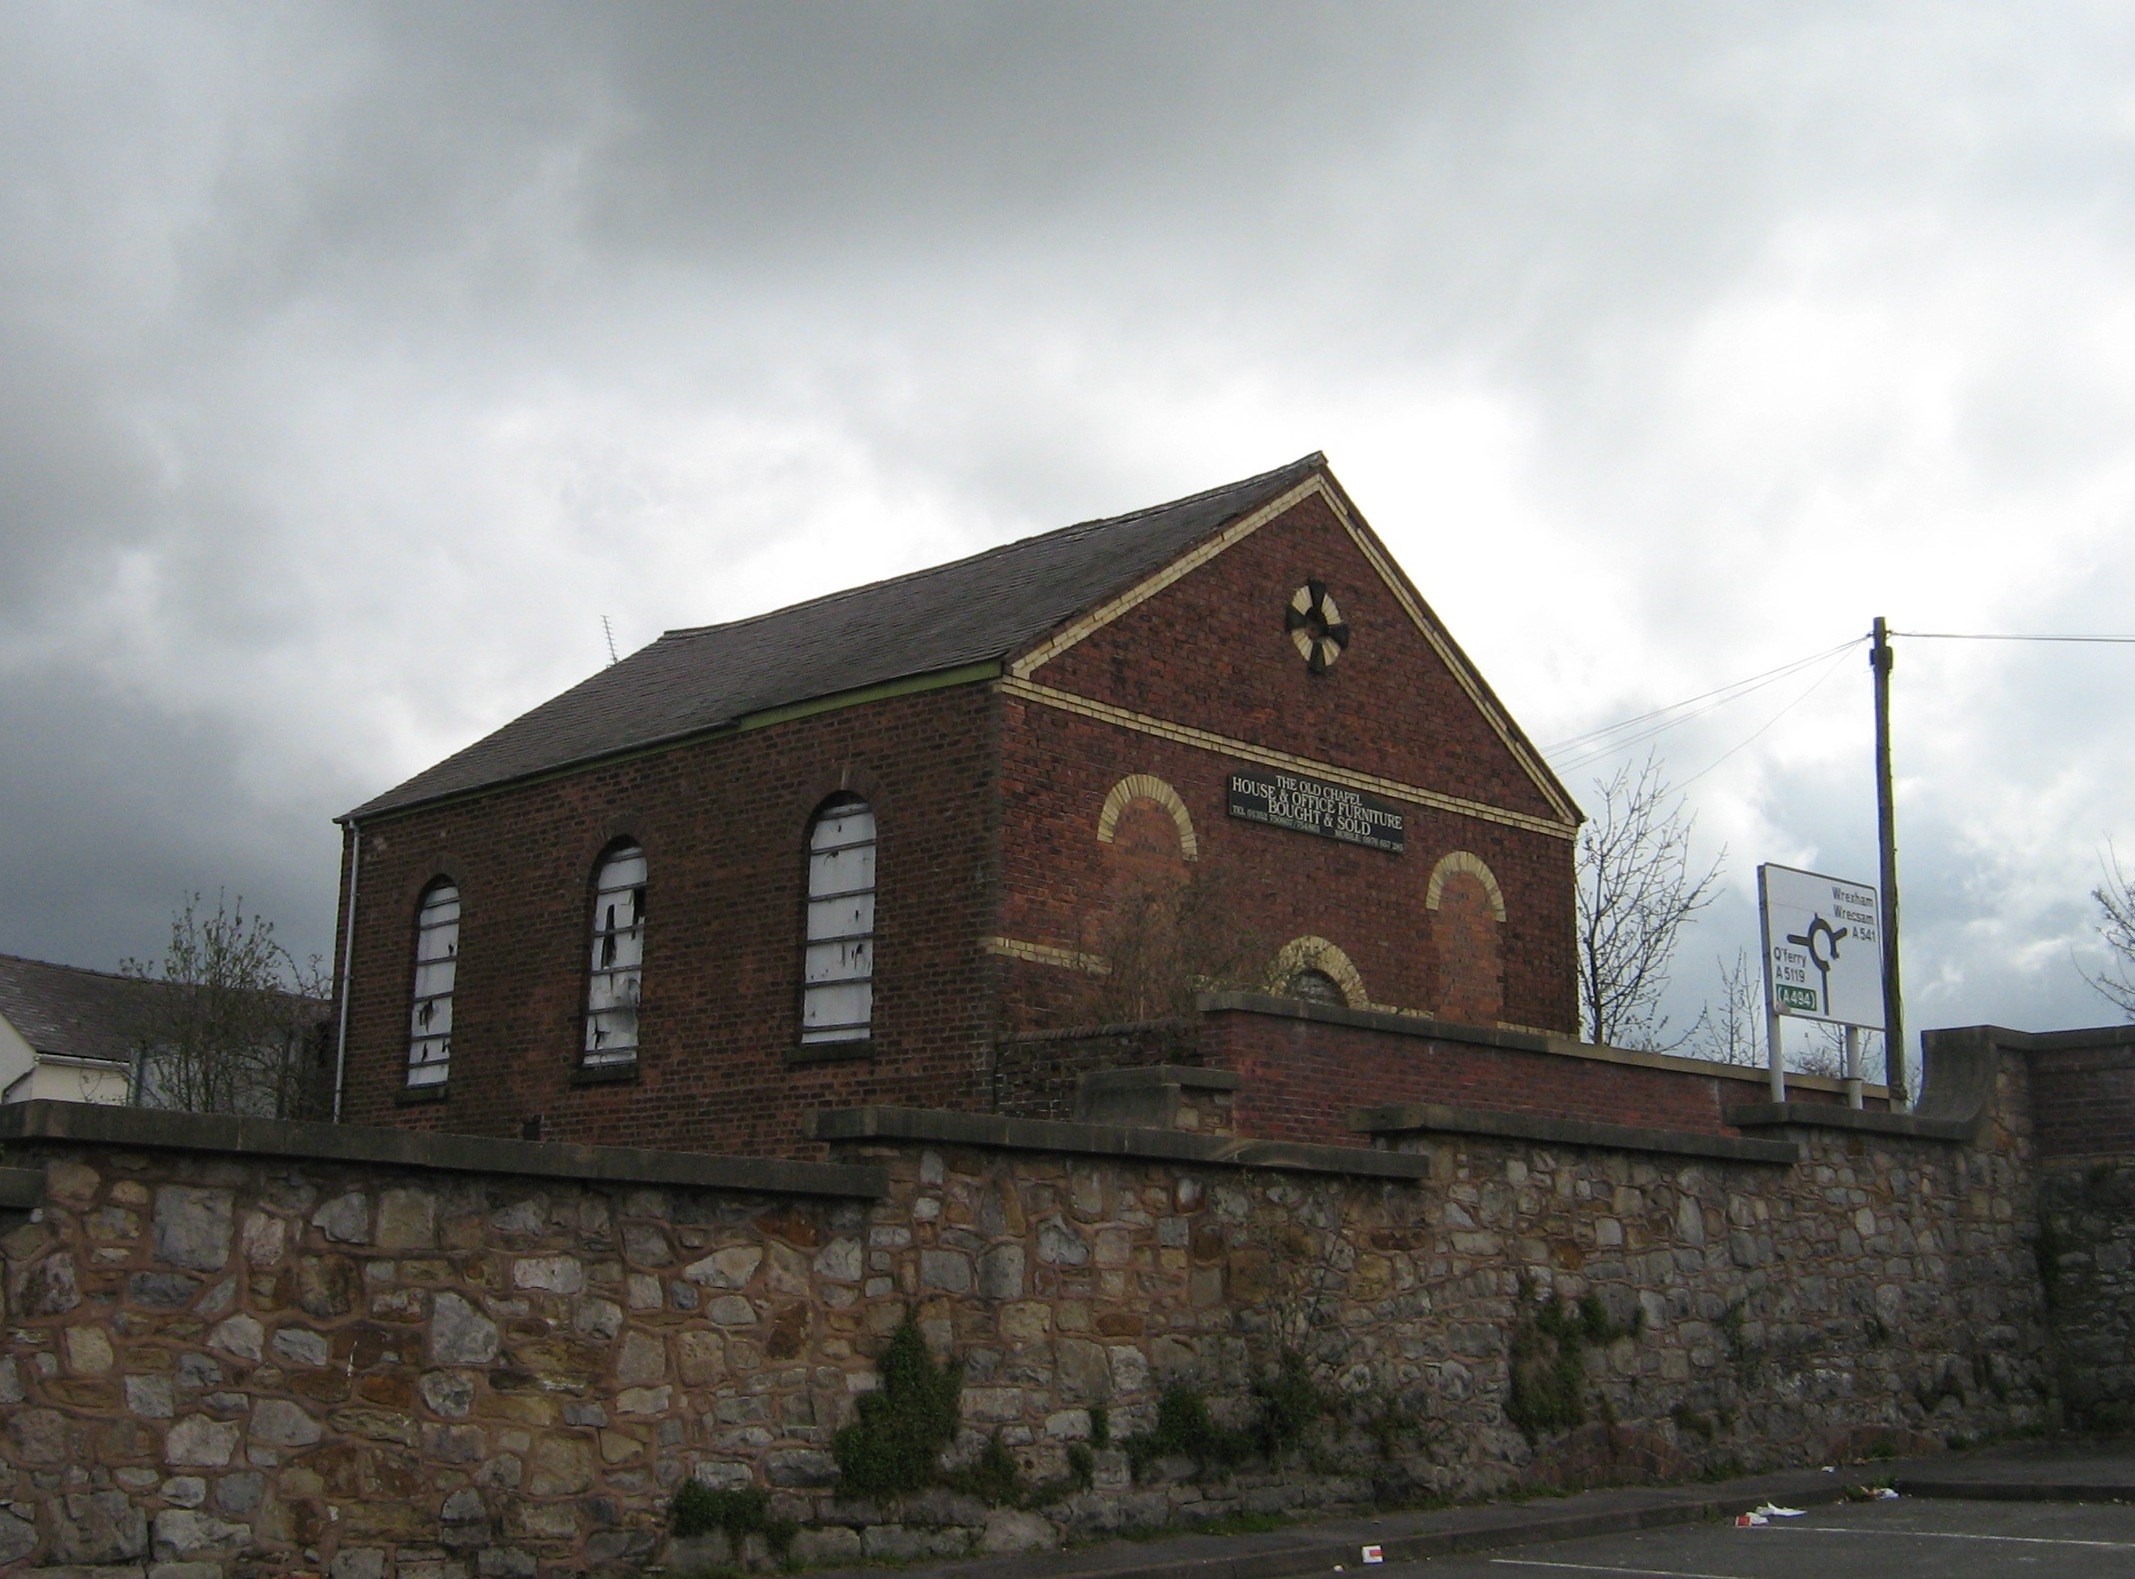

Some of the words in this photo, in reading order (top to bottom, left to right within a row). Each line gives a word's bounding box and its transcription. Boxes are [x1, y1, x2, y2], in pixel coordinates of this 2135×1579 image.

[1232, 776, 1277, 800] HOUSE
[1279, 788, 1288, 803] &
[1292, 791, 1336, 814] OFFICE
[1338, 802, 1403, 830] FURNITURE
[1276, 775, 1297, 790] THE
[1300, 781, 1321, 796] OLD
[1323, 786, 1363, 806] CHAPEL
[1268, 799, 1321, 825] BOUGHT
[1324, 813, 1333, 828] &
[1337, 816, 1371, 836] SOLD
[1832, 887, 1873, 906] Wrexham
[1833, 905, 1874, 924] Wrecsam
